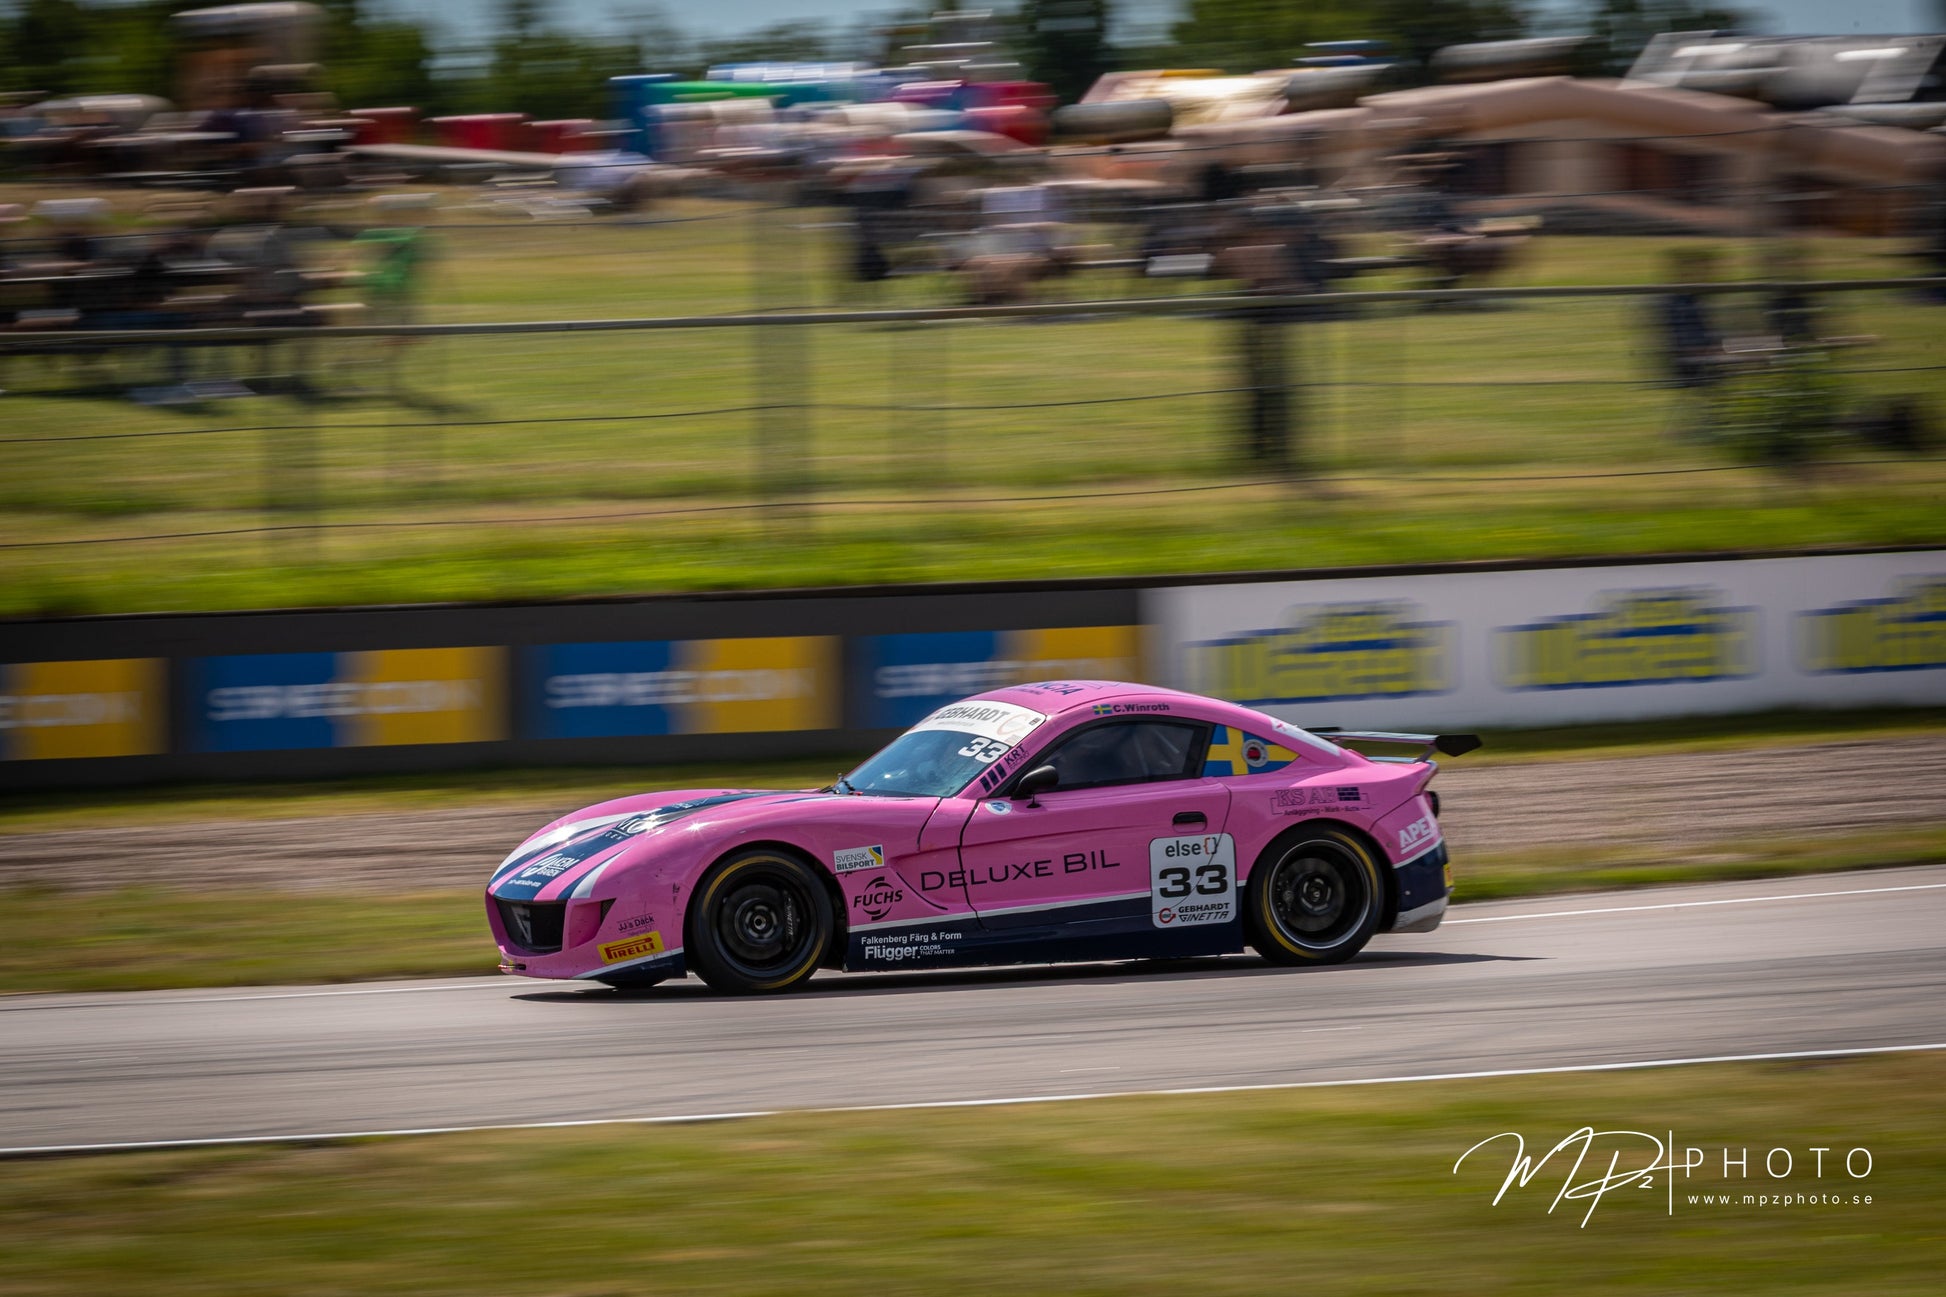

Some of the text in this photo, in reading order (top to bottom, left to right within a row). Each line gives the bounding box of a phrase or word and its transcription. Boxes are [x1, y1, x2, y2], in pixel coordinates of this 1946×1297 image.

[1113, 703, 1170, 713] C.Winroth
[957, 736, 1010, 764] 33
[1003, 743, 1025, 765] KRT
[836, 852, 867, 863] SVENSK
[836, 859, 875, 871] BILSPORT
[920, 850, 1120, 891] DELUXE BIL
[1159, 864, 1228, 898] 33
[854, 890, 903, 908] FUCHS
[1178, 902, 1230, 913] GEBHARDT
[1178, 911, 1229, 922] GINETTA
[861, 932, 962, 945] Falkenberg Färg & Form
[604, 937, 655, 960] PIRELLI
